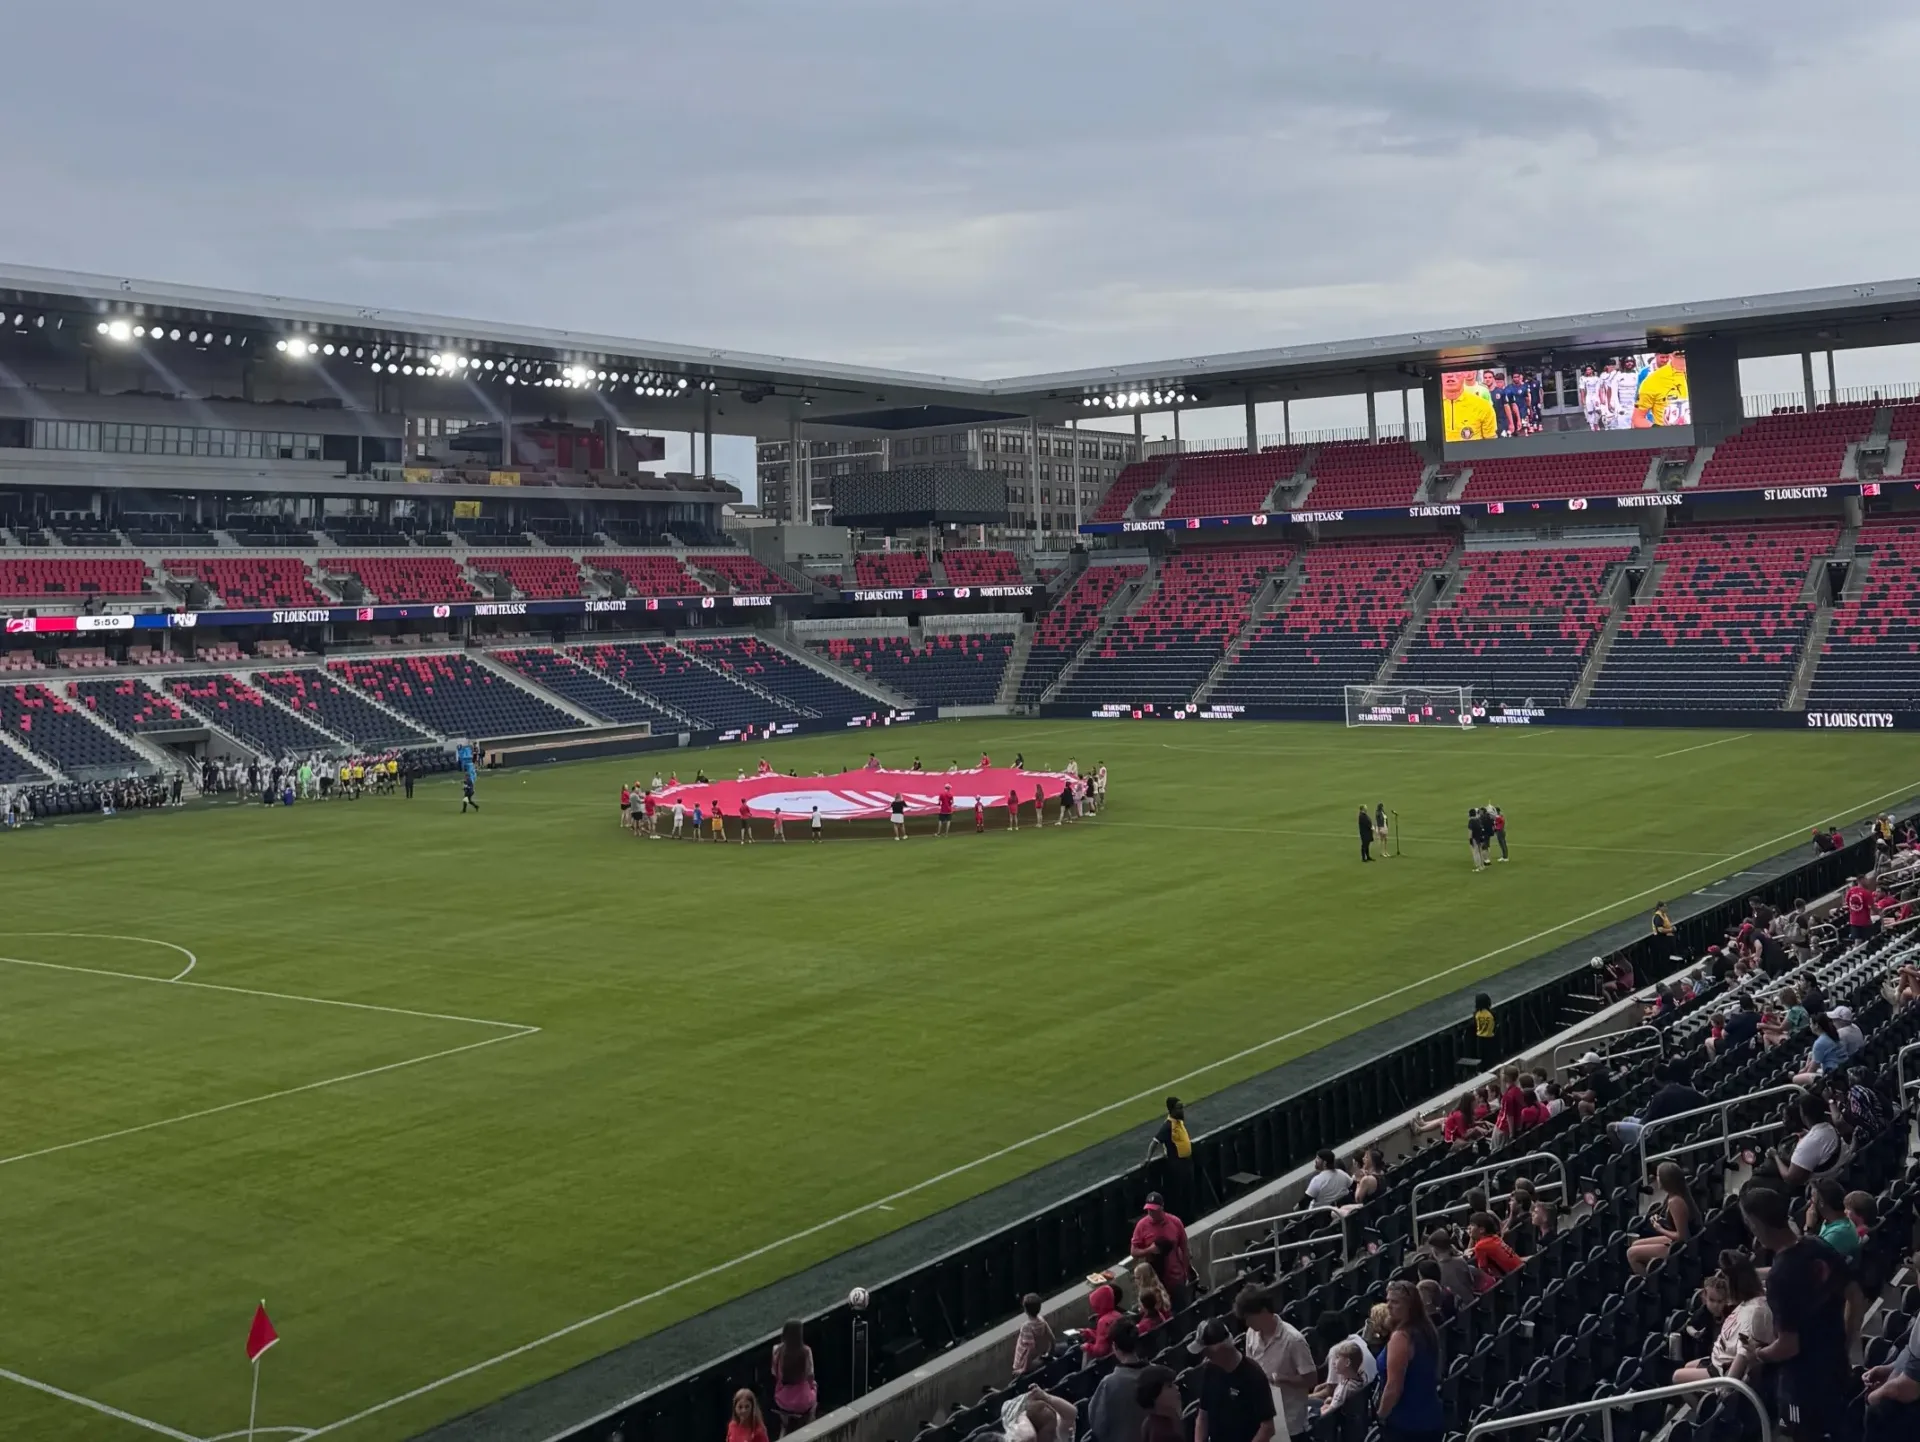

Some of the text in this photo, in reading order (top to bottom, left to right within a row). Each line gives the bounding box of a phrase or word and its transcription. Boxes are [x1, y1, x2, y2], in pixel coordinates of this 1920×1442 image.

[1764, 487, 1827, 500] ST LOUIS CITY2
[1618, 494, 1682, 507] NORTH TEXAS SC
[1291, 511, 1344, 523] NORTH TEXAS SC
[1409, 505, 1460, 517] ST LOUIS CITY2
[1123, 521, 1165, 531] ST LOUIS CITY2
[855, 591, 903, 601] ST LOUIS CITY2
[980, 586, 1033, 597] NORTH TEXAS SC
[585, 601, 593, 611] ST
[593, 601, 610, 611] LOUIS
[733, 596, 772, 606] NORTH TEXAS SC
[475, 603, 526, 615] NORTH TEXAS SC
[94, 618, 119, 626] 5:50
[273, 610, 329, 623] ST LOUIS CITY2
[1807, 713, 1893, 727] ST LOUIS CITY2
